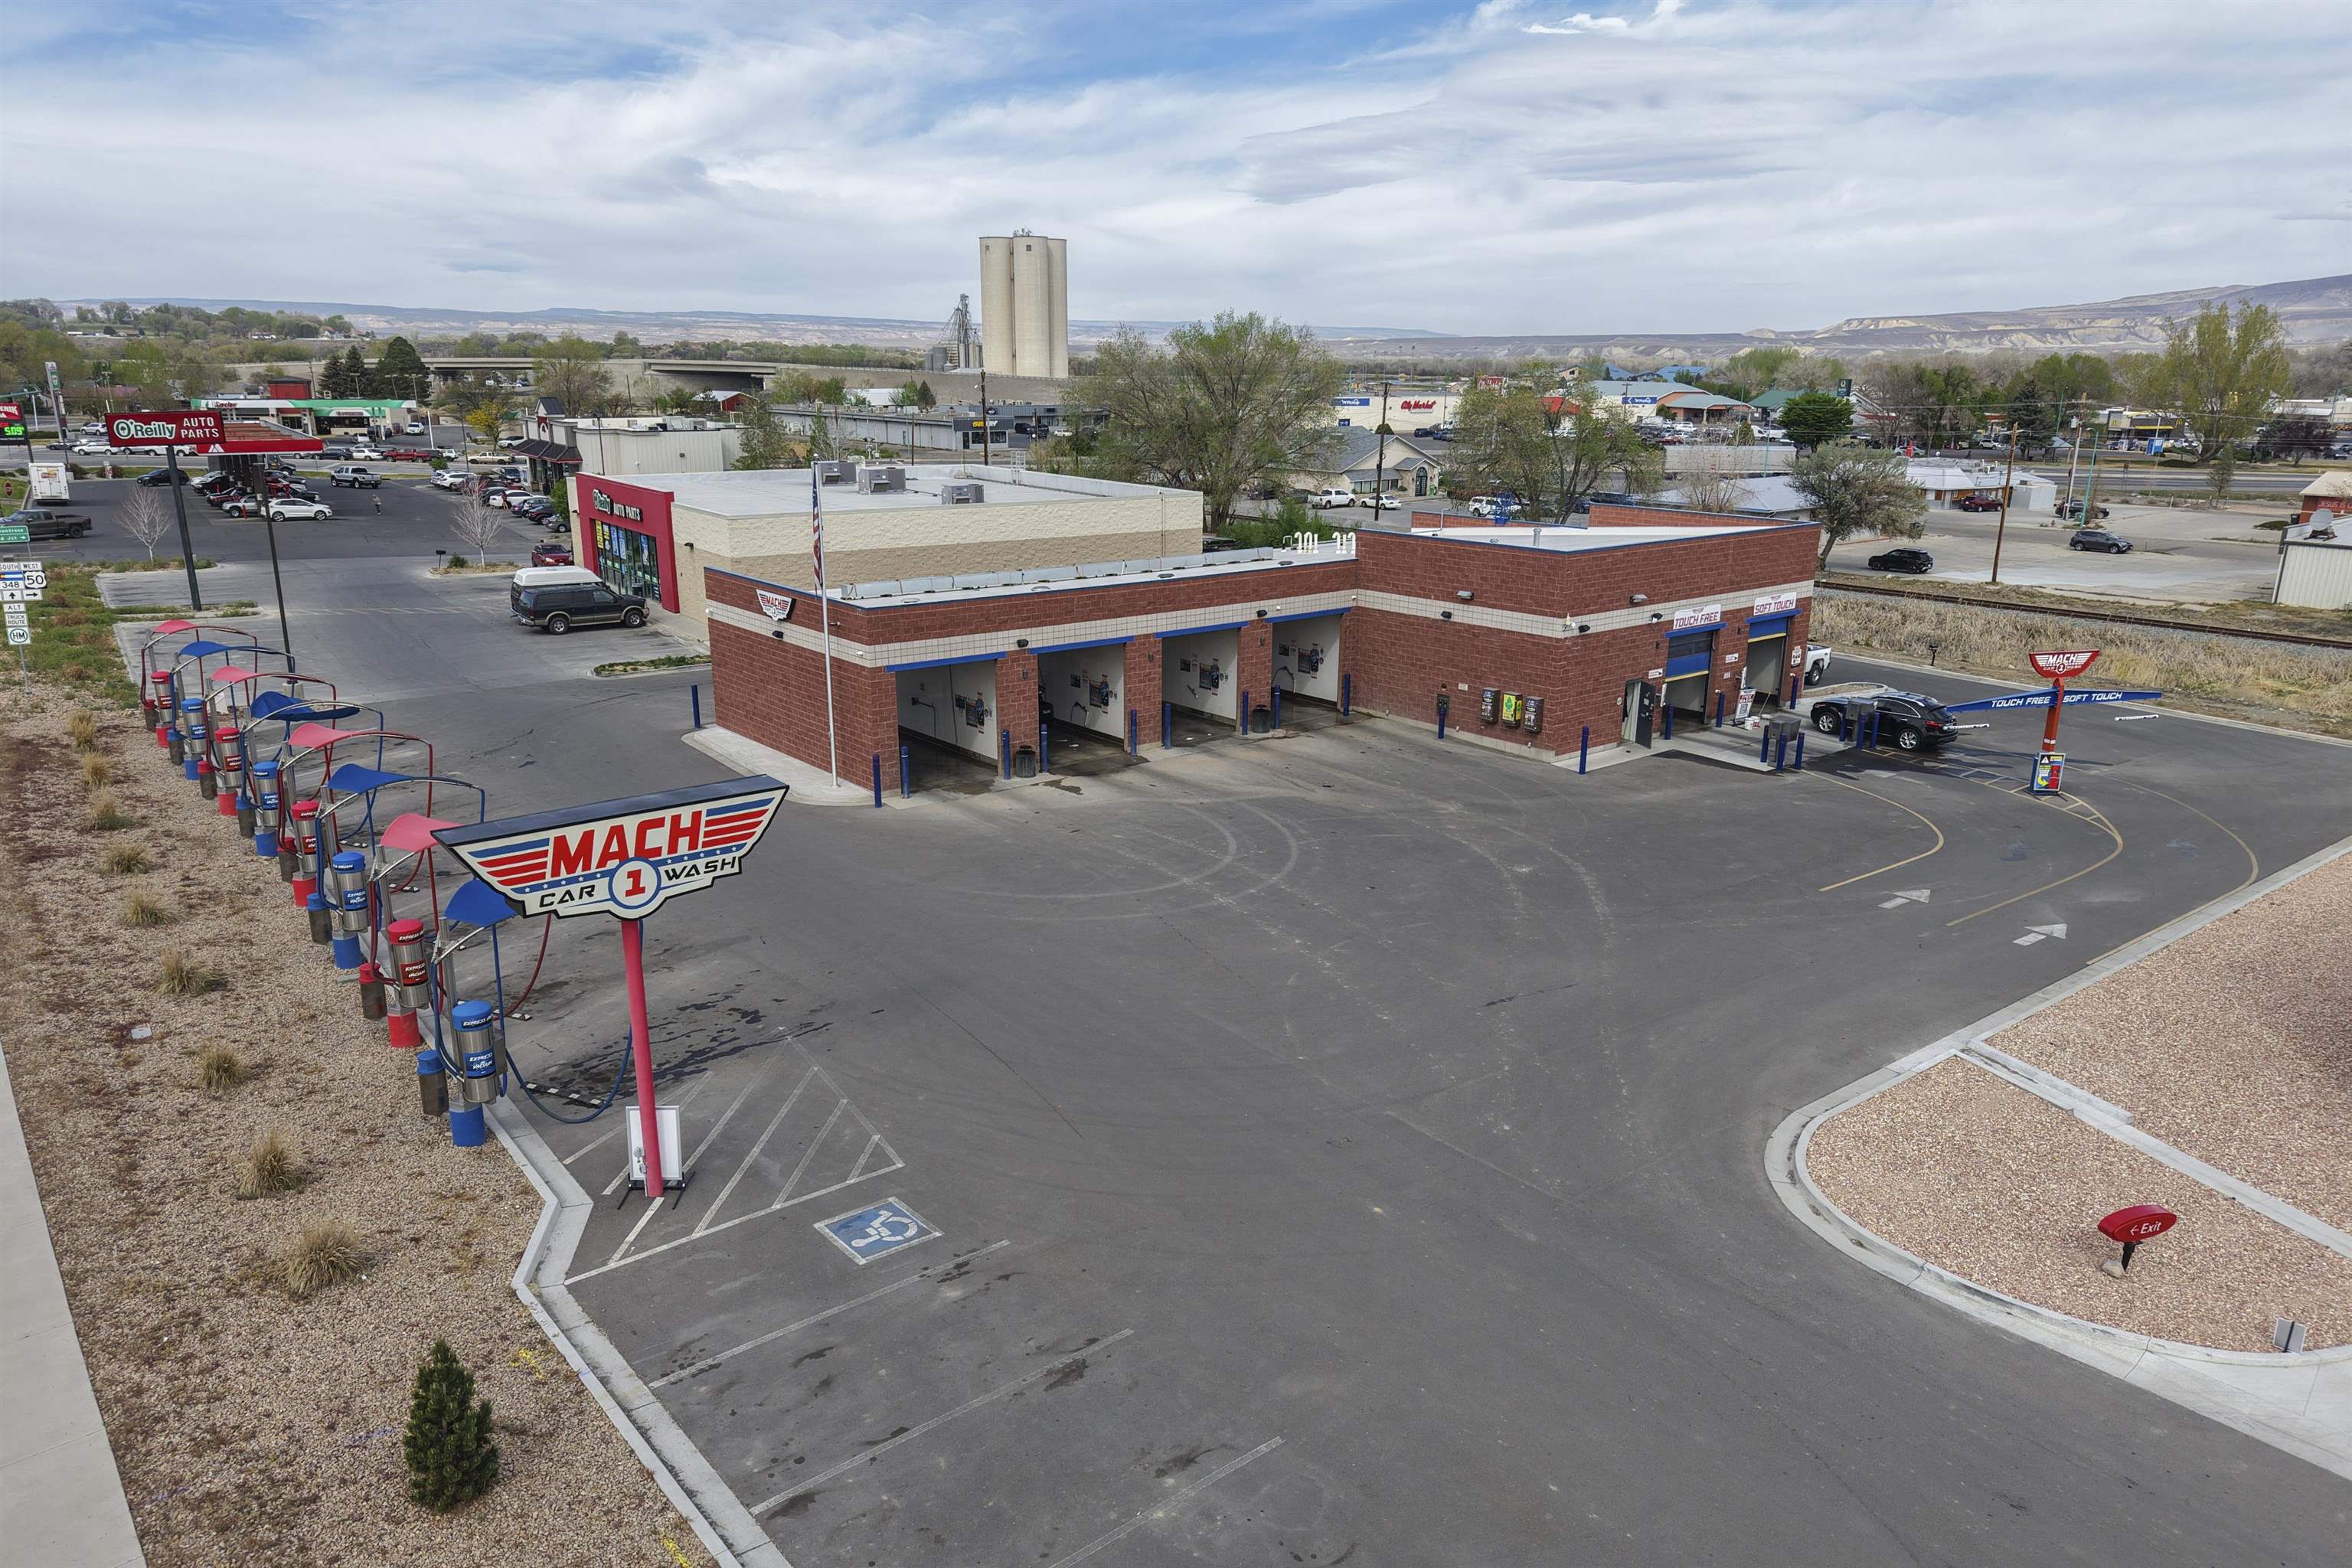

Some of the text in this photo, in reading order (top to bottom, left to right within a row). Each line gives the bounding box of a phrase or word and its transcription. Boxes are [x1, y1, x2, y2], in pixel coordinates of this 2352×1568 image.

[183, 416, 214, 427] AUTO
[114, 419, 176, 439] O'Reilly
[181, 428, 220, 439] PARTS
[27, 575, 44, 585] 50
[766, 595, 782, 609] MACH
[1755, 599, 1795, 614] SOFT TOUCH
[1674, 611, 1719, 629] TOUCH FREE
[2047, 653, 2078, 665] MACH
[1991, 696, 2051, 707] TOUCH FREE
[2063, 692, 2123, 703] SOFT TOUCH
[550, 810, 702, 878] MACH
[539, 857, 737, 908] CAR 1 WASH
[469, 1052, 492, 1062] EXPRESS
[472, 1060, 493, 1070] VACUUM
[2140, 1220, 2161, 1234] Exit
